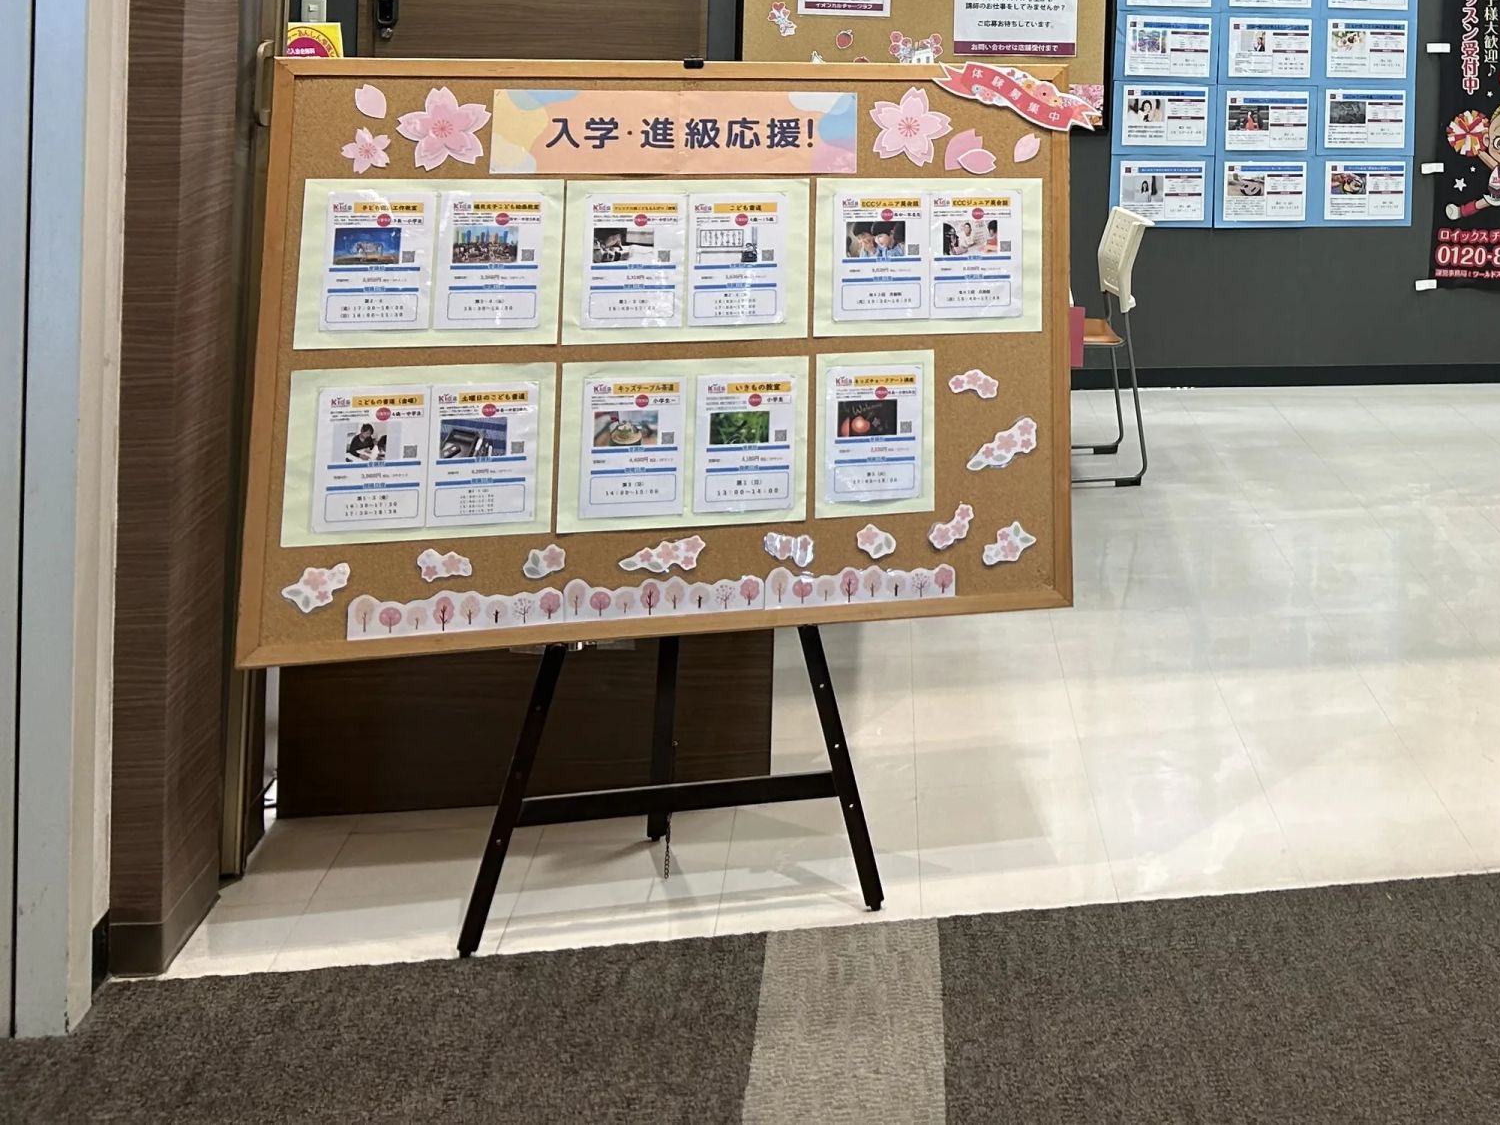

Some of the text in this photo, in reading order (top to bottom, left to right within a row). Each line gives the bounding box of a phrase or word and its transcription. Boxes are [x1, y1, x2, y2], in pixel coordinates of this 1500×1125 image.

[977, 20, 1055, 29] ご応募お待ちしています。
[971, 43, 1058, 53] お問い合わせは店舗受付まで
[545, 116, 815, 150] 入学・進級応援!
[1440, 230, 1489, 241] ロイックス
[617, 383, 674, 392] キッズテーブル茶道
[735, 383, 781, 392] いきもの教室
